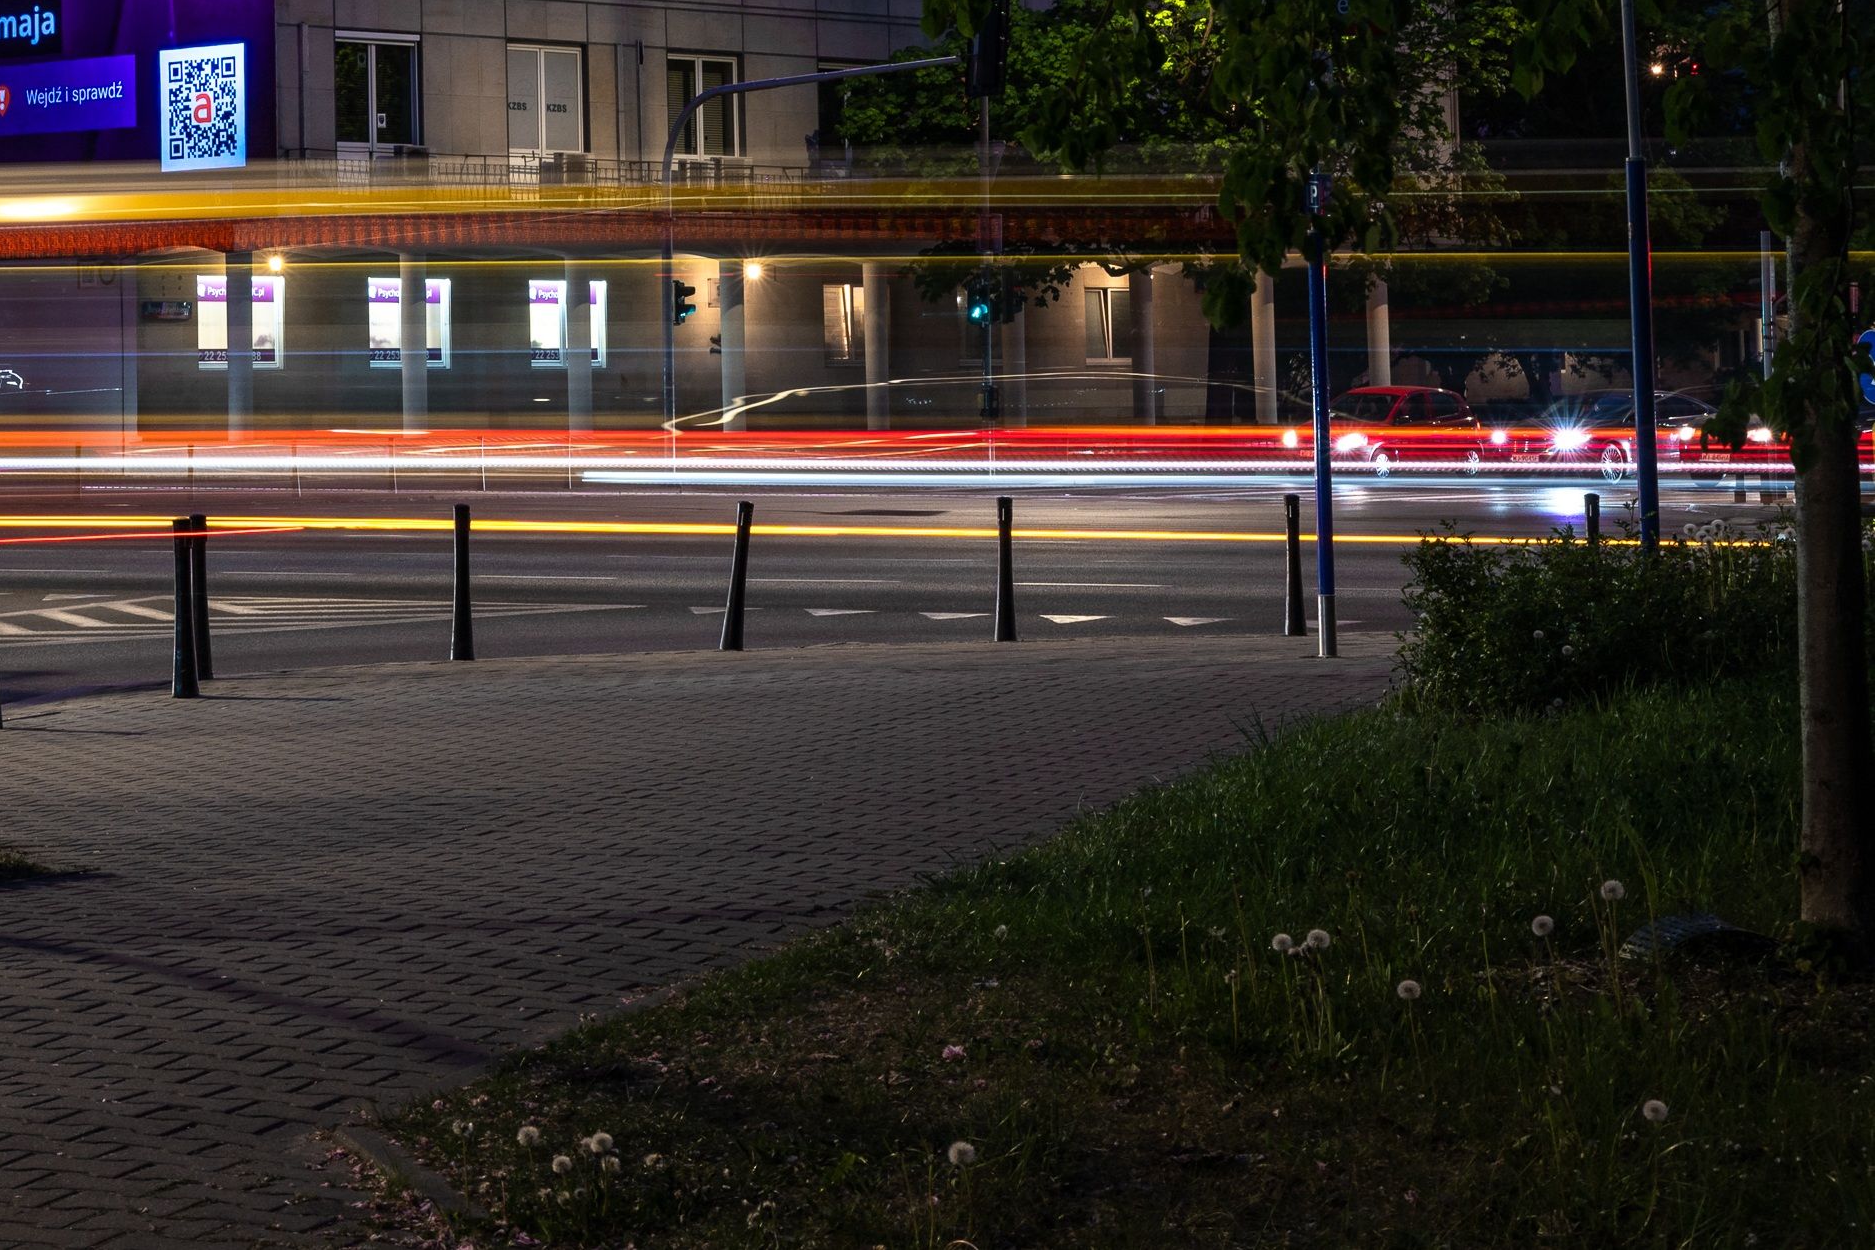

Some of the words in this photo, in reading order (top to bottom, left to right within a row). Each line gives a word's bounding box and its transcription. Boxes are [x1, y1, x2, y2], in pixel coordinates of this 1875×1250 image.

[26, 84, 62, 107] Wejdź
[72, 81, 123, 106] sprawdź
[216, 351, 228, 360] 25
